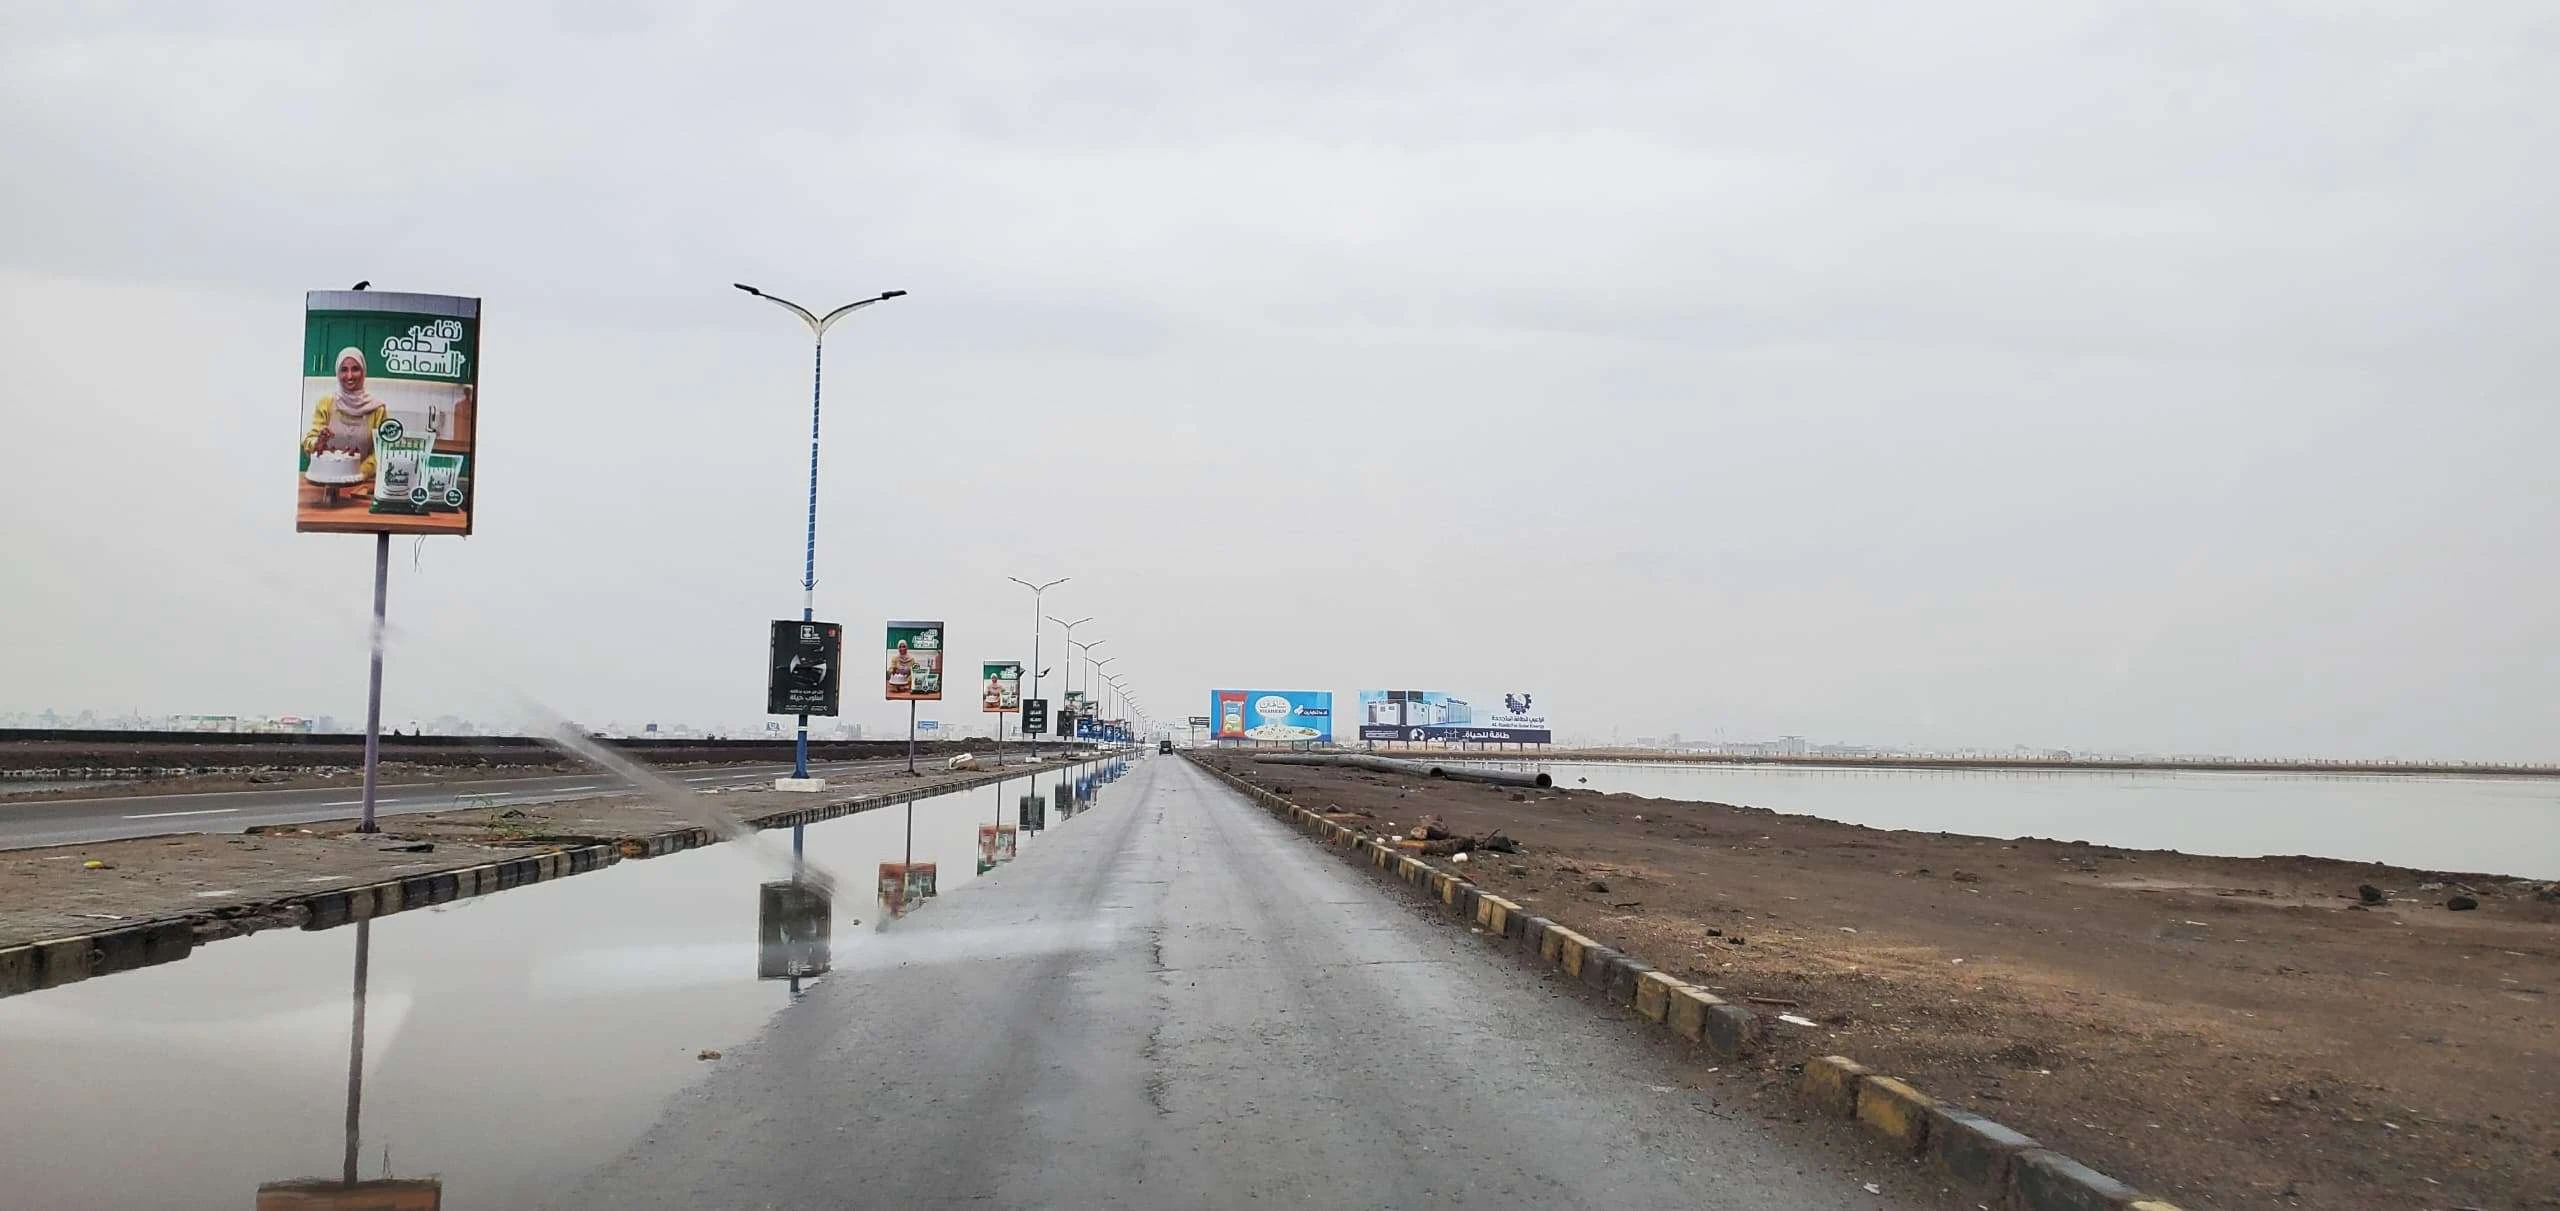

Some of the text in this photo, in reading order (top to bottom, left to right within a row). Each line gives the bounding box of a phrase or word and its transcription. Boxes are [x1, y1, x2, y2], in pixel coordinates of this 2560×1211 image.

[422, 320, 462, 340] نقاء
[382, 327, 448, 358] بطعم
[387, 351, 461, 377] السعادة
[1489, 730, 1510, 739] طاقة
